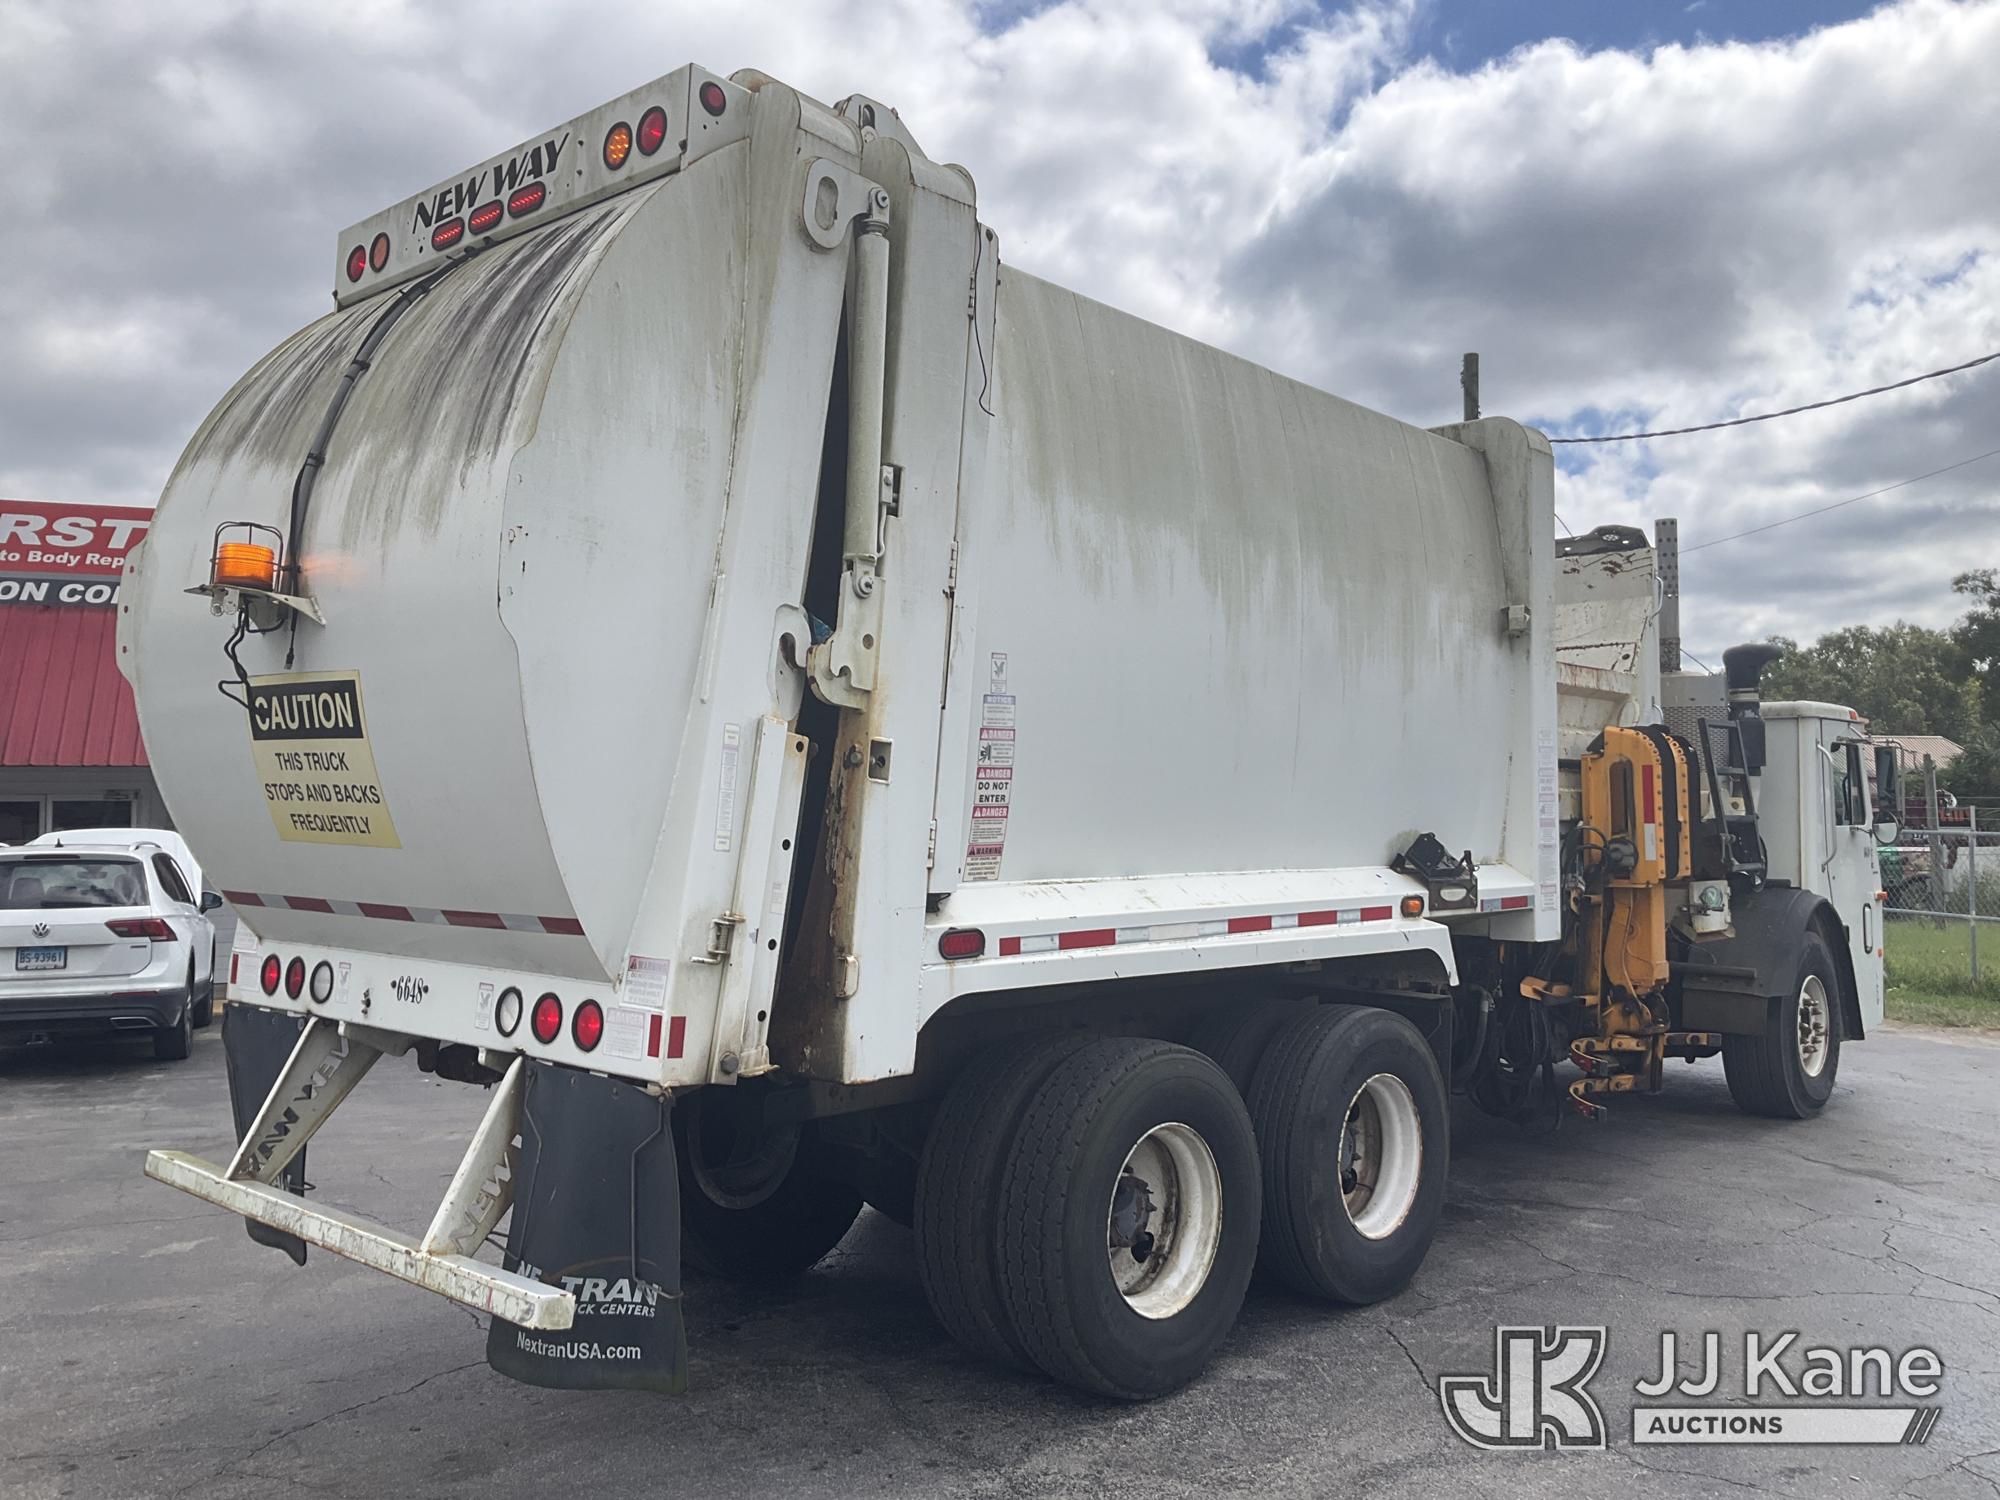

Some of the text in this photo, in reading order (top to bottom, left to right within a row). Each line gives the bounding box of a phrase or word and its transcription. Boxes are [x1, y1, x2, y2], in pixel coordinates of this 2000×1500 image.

[412, 132, 570, 234] NEW WAY
[27, 550, 81, 566] Body
[254, 692, 354, 731] CAUTION
[275, 752, 349, 771] THIS TRUCK
[985, 768, 1011, 779] DANGER
[265, 783, 381, 804] STOPS AND BACKS
[978, 782, 1009, 790] DO NOT
[979, 794, 1006, 803] ENTER
[981, 806, 1008, 817] DANGER
[290, 813, 371, 834] FREQUENTLY
[396, 975, 424, 1004] 6648
[600, 1303, 656, 1318] CENTERS
[516, 1331, 641, 1360] NextranUSA.com
